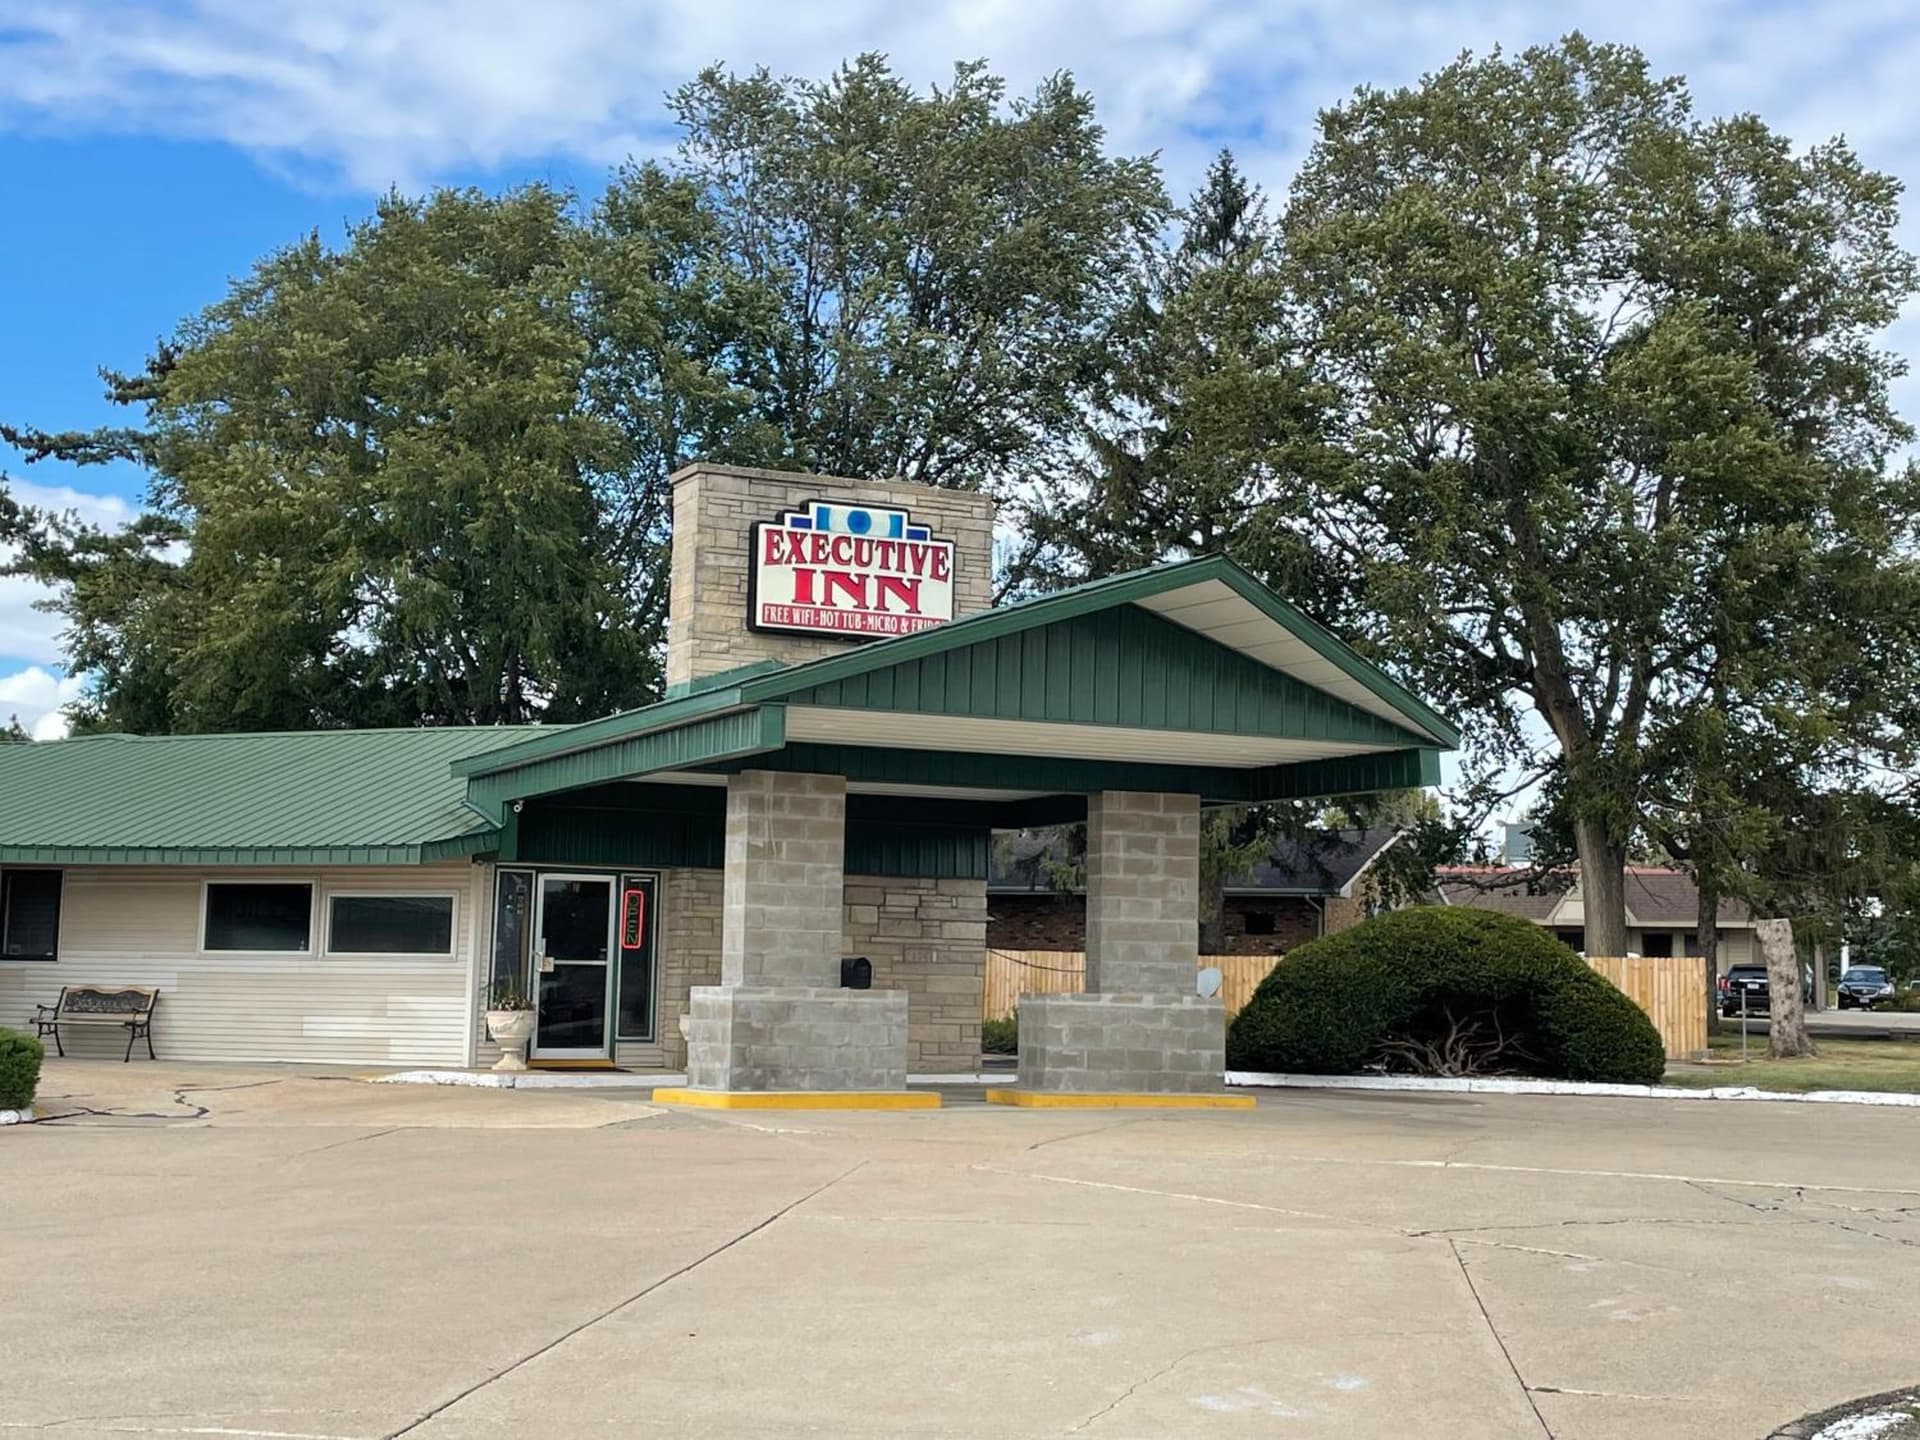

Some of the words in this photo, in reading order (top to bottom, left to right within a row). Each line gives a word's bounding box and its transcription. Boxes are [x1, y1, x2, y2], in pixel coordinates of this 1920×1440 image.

[764, 528, 949, 582] EXECUTIVE
[792, 567, 921, 614] INN
[764, 605, 790, 623] FREE
[912, 618, 946, 633] FRID
[627, 895, 639, 944] OPEN
